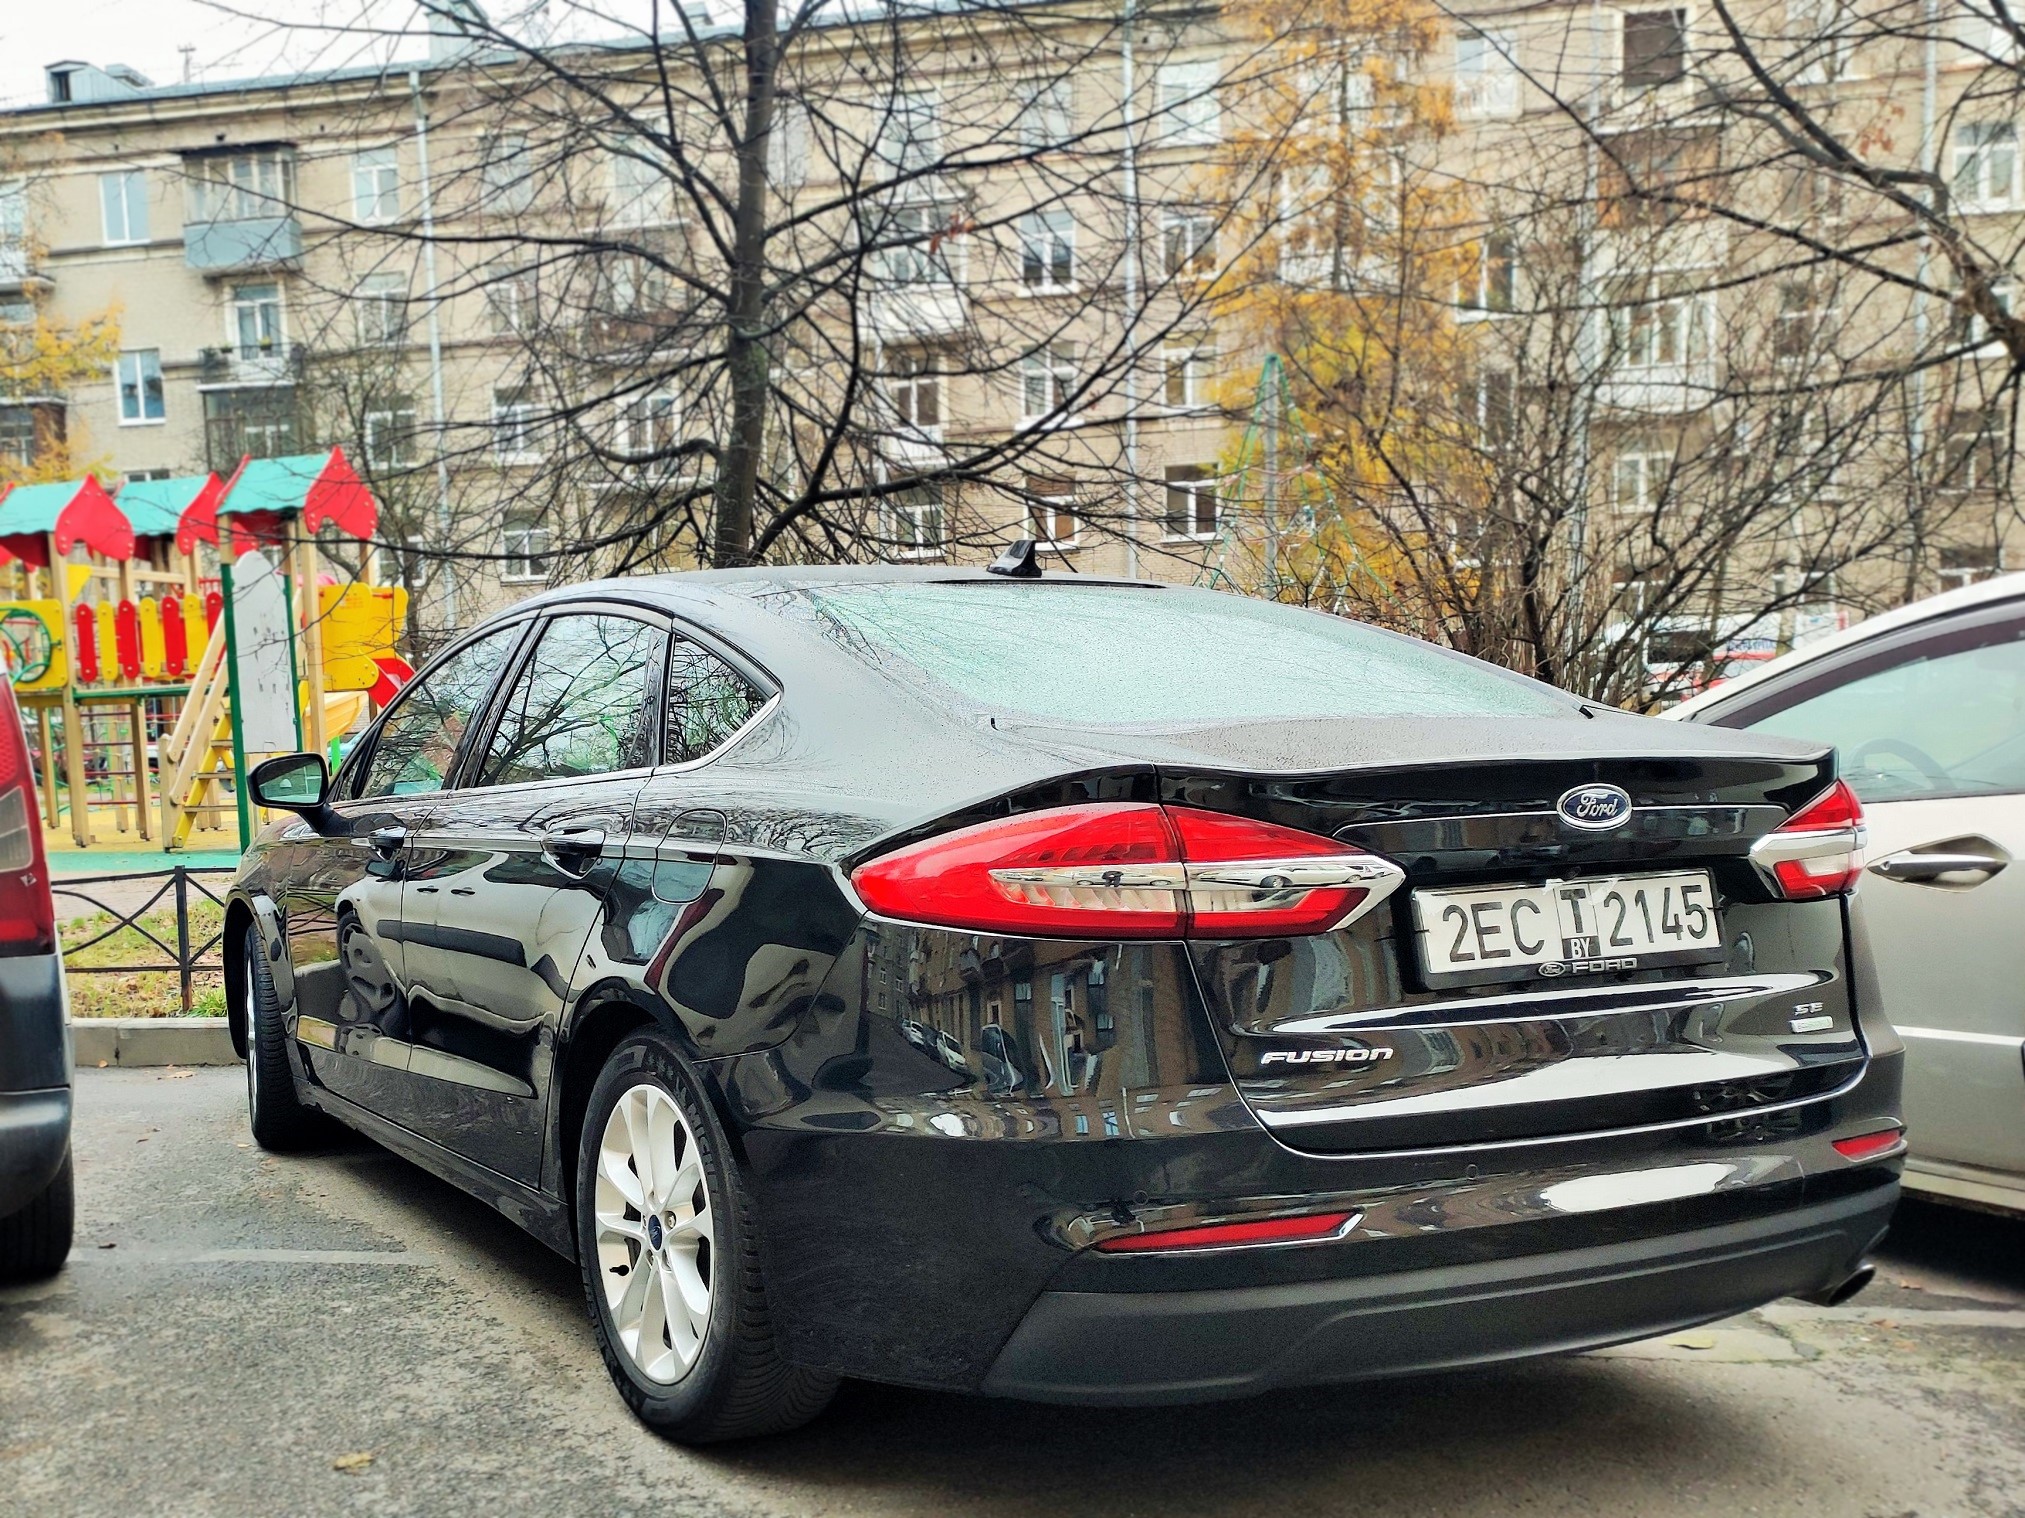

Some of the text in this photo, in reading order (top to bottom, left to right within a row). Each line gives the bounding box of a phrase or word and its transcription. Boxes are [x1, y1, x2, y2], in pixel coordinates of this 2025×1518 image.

[1576, 793, 1619, 817] Ford
[1442, 884, 1709, 962] 2EC T 2145
[1570, 937, 1591, 959] BY
[1571, 957, 1638, 974] FORD
[1793, 1002, 1824, 1016] SE
[1260, 1047, 1394, 1065] FUSION
